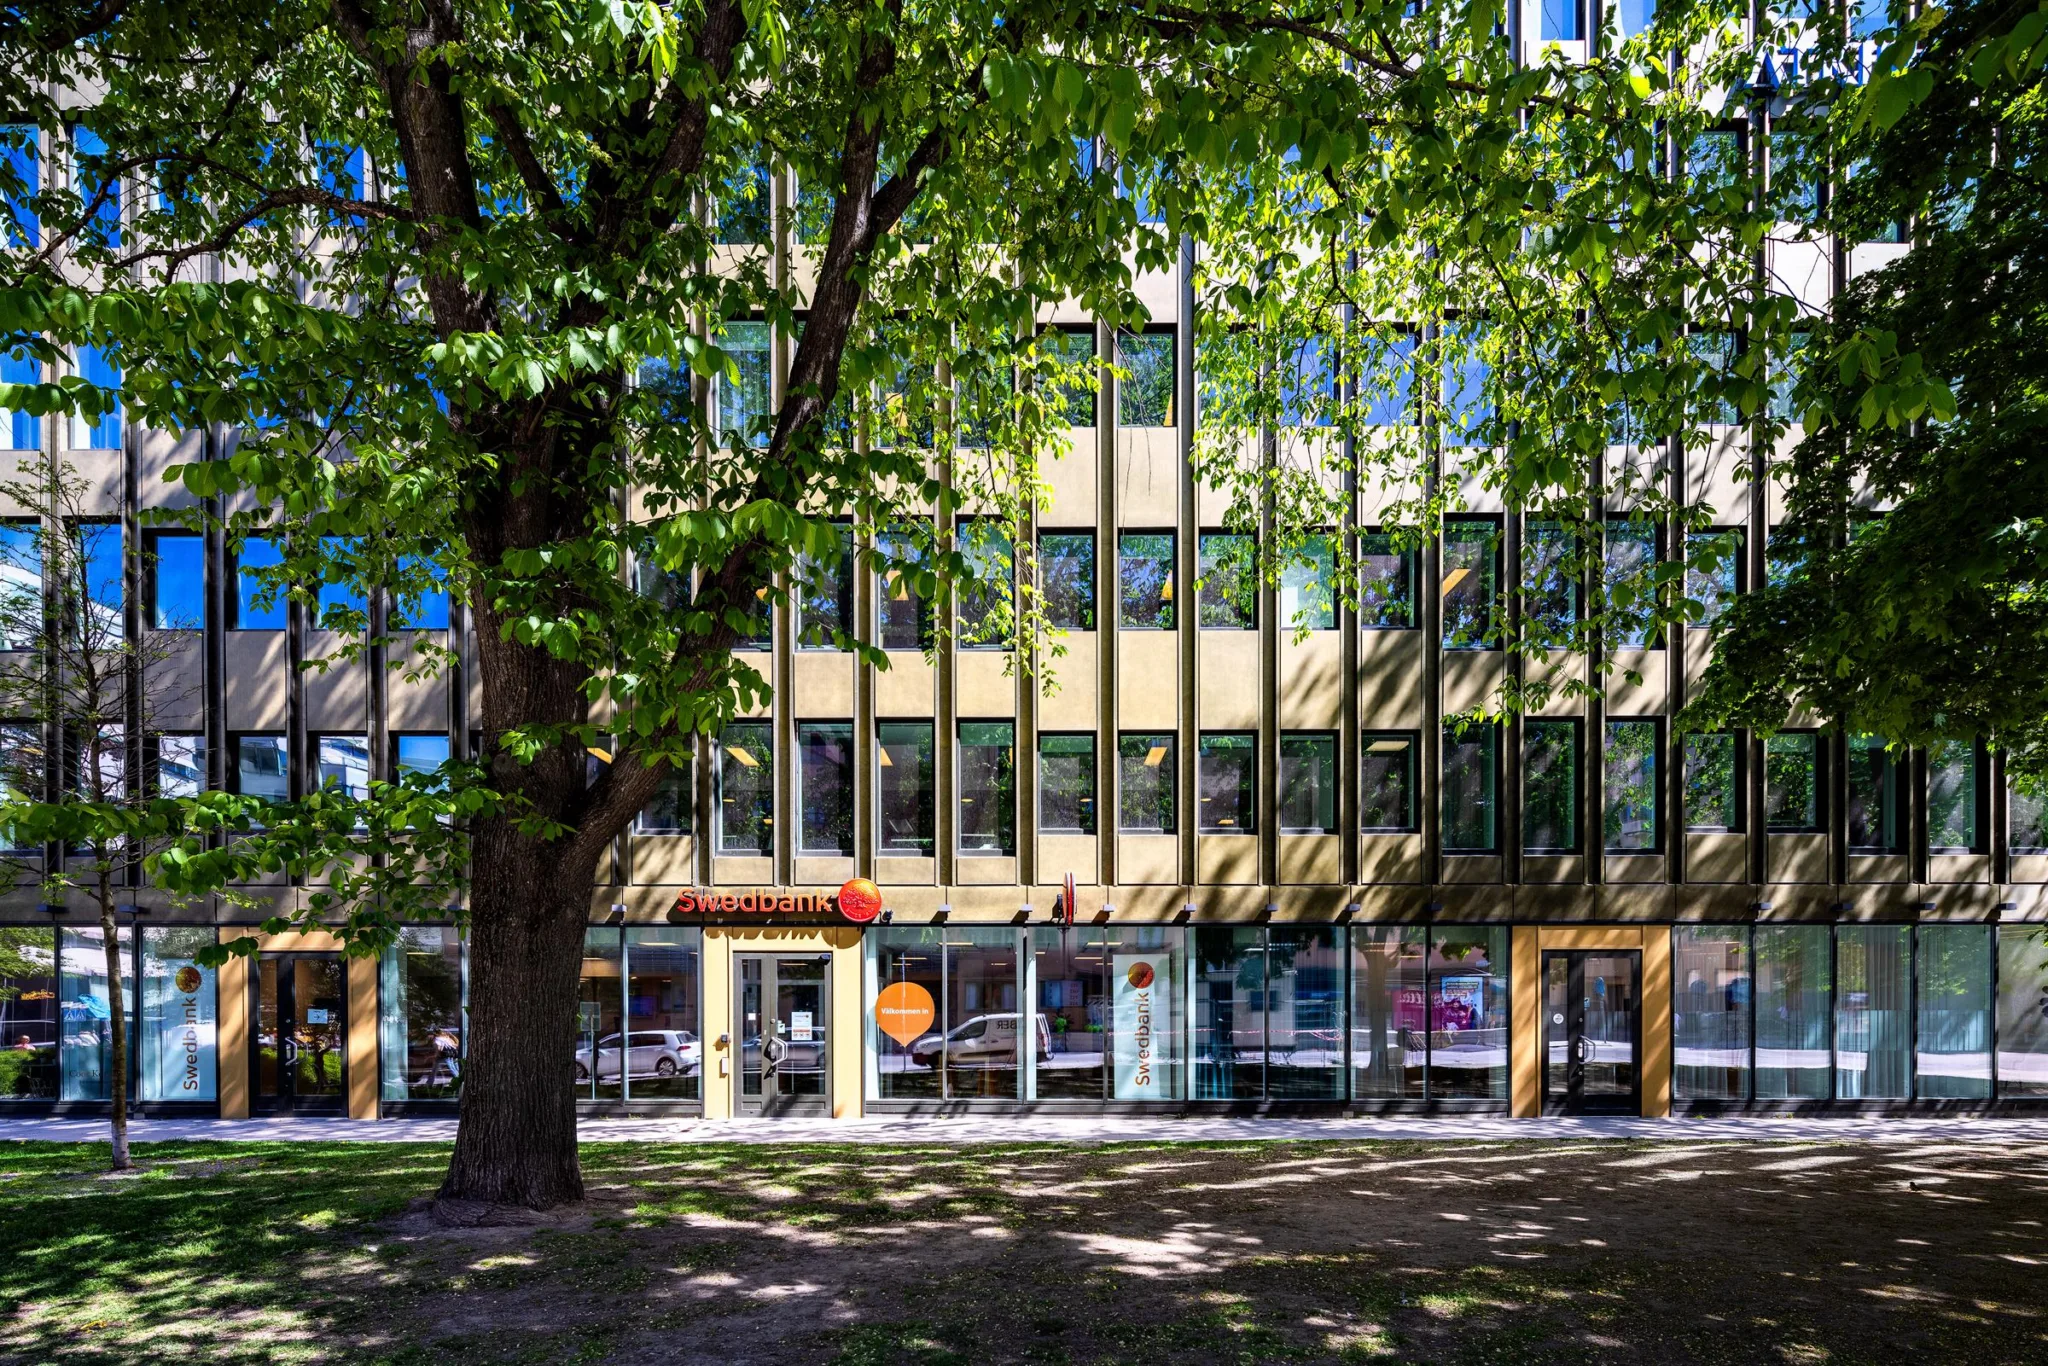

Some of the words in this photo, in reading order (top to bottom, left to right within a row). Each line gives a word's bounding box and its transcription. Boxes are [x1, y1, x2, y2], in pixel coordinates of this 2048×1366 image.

[676, 887, 832, 913] Swedbank
[881, 1007, 920, 1015] Välkommen
[922, 1007, 929, 1015] in
[1134, 992, 1151, 1086] Swedbank
